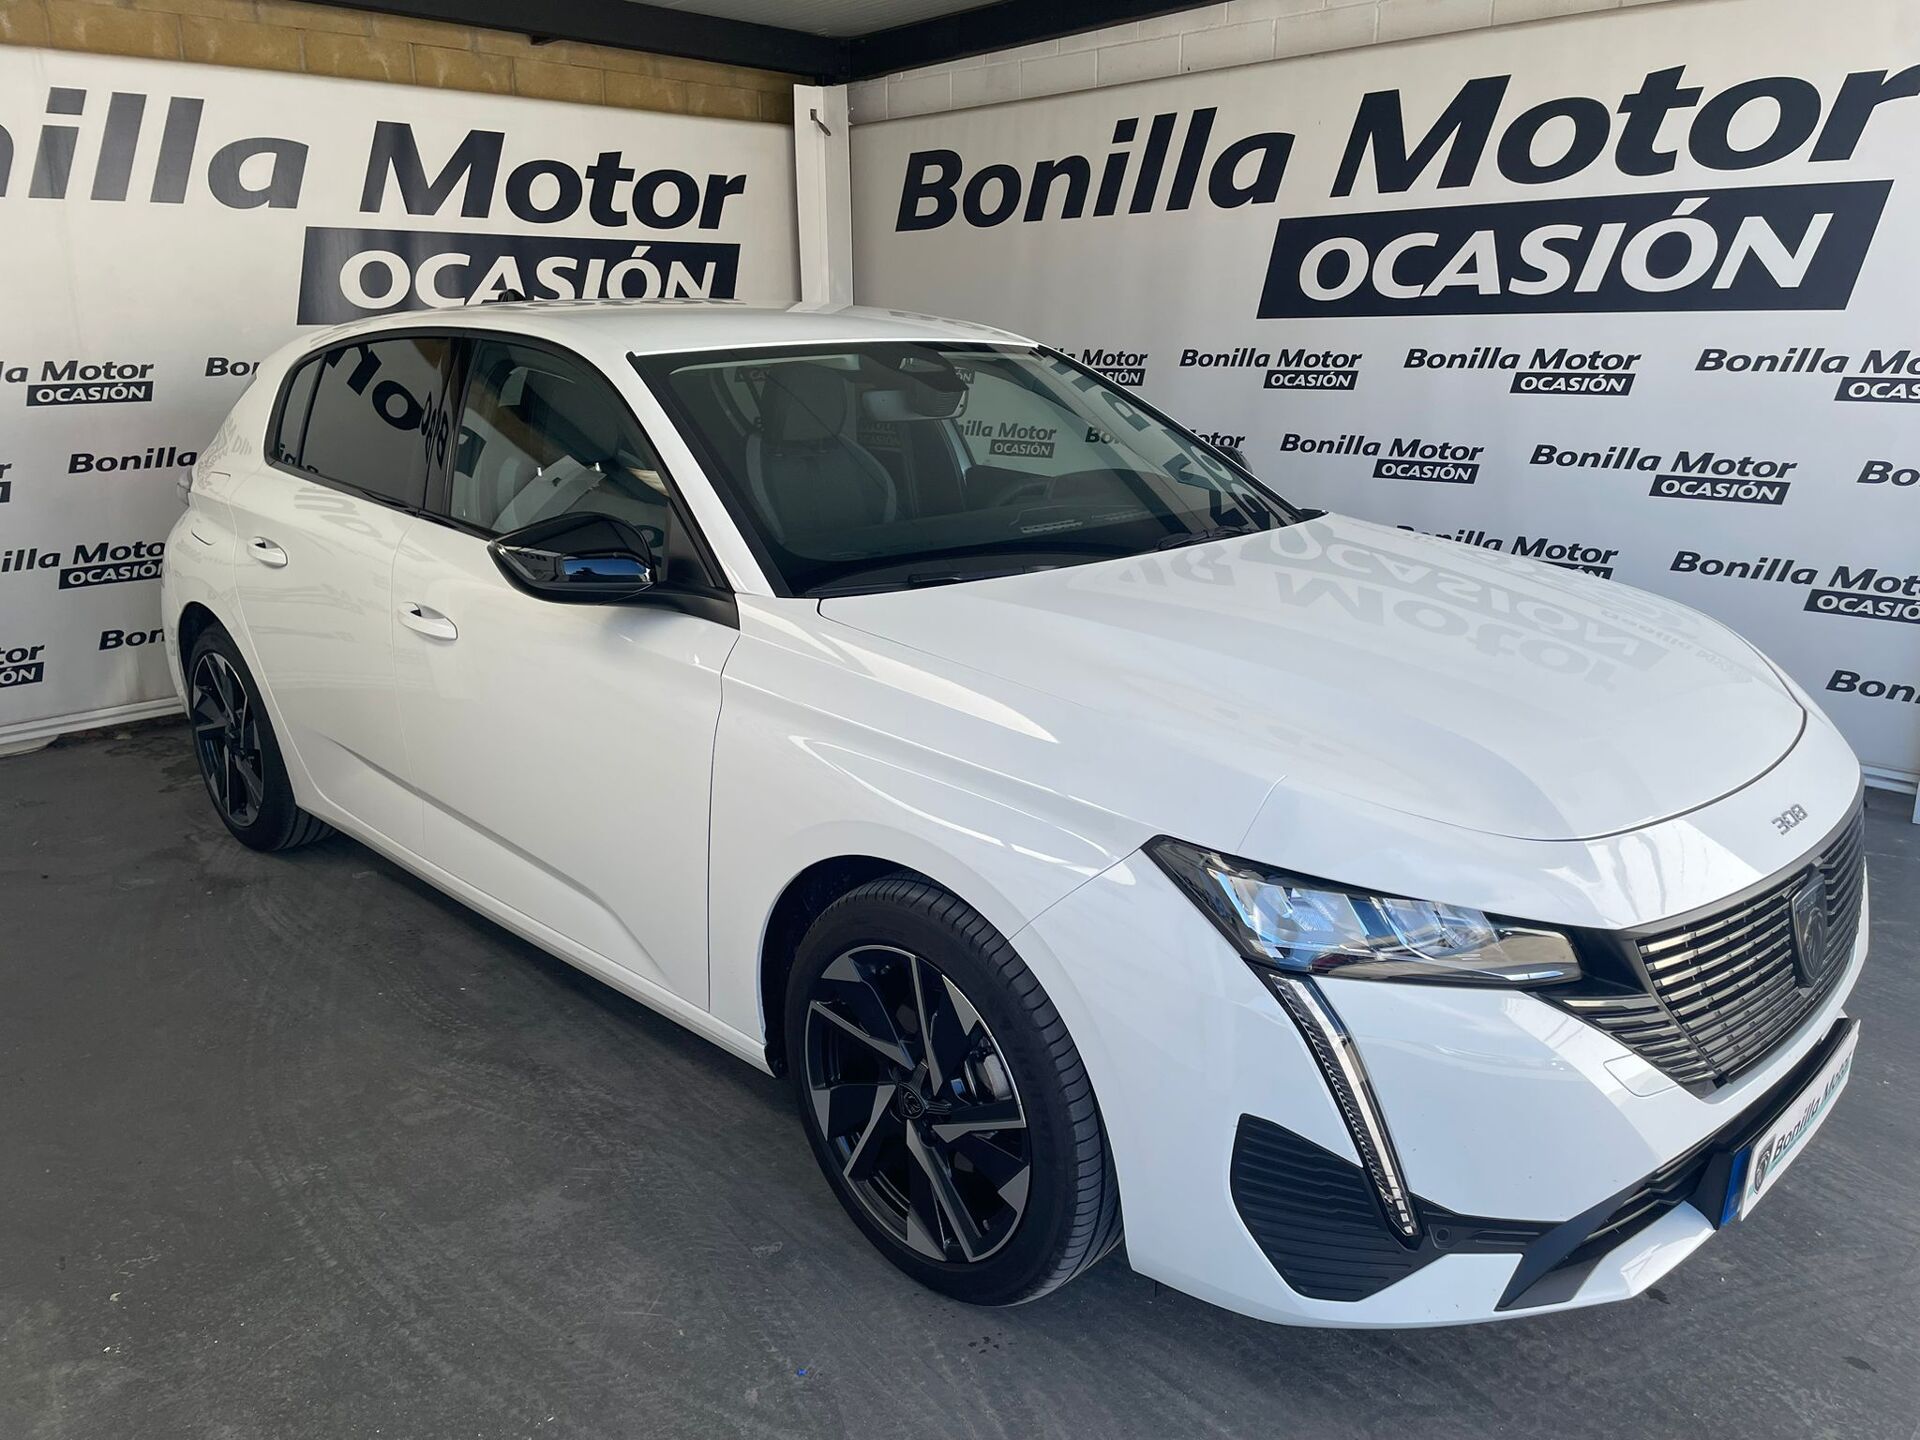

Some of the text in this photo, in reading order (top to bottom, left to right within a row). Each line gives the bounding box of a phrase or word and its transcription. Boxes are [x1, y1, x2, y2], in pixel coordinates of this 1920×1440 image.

[0, 87, 747, 229] illa Motor
[895, 65, 1920, 232] Bonilla Motor
[1300, 197, 1834, 300] OCASIÓN
[339, 246, 718, 309] OCASIÓN
[1082, 349, 1148, 366] Motor
[1179, 347, 1362, 368] Bonilla Motor
[1404, 347, 1641, 370] Bonilla Motor
[1695, 348, 1849, 373] Bonilla
[41, 361, 154, 381] Motor
[1271, 372, 1351, 386] OCASIÓN
[1521, 375, 1626, 391] OCASIÓN
[36, 383, 145, 402] OCASIÓN
[998, 422, 1056, 440] Motor
[1190, 429, 1245, 448] otor
[994, 443, 1050, 455] OCASIÓN
[1280, 434, 1484, 460] Bonilla Motor
[69, 447, 198, 473] Bonilla
[1382, 464, 1472, 480] OCASIÓN
[1530, 445, 1797, 478] Bonilla Motor
[1661, 480, 1779, 500] OCASIÓN
[1511, 536, 1618, 564] Motor
[1670, 551, 1818, 584] Bonilla
[1771, 804, 1808, 835] 308
[1772, 1097, 1821, 1161] Bonilla
